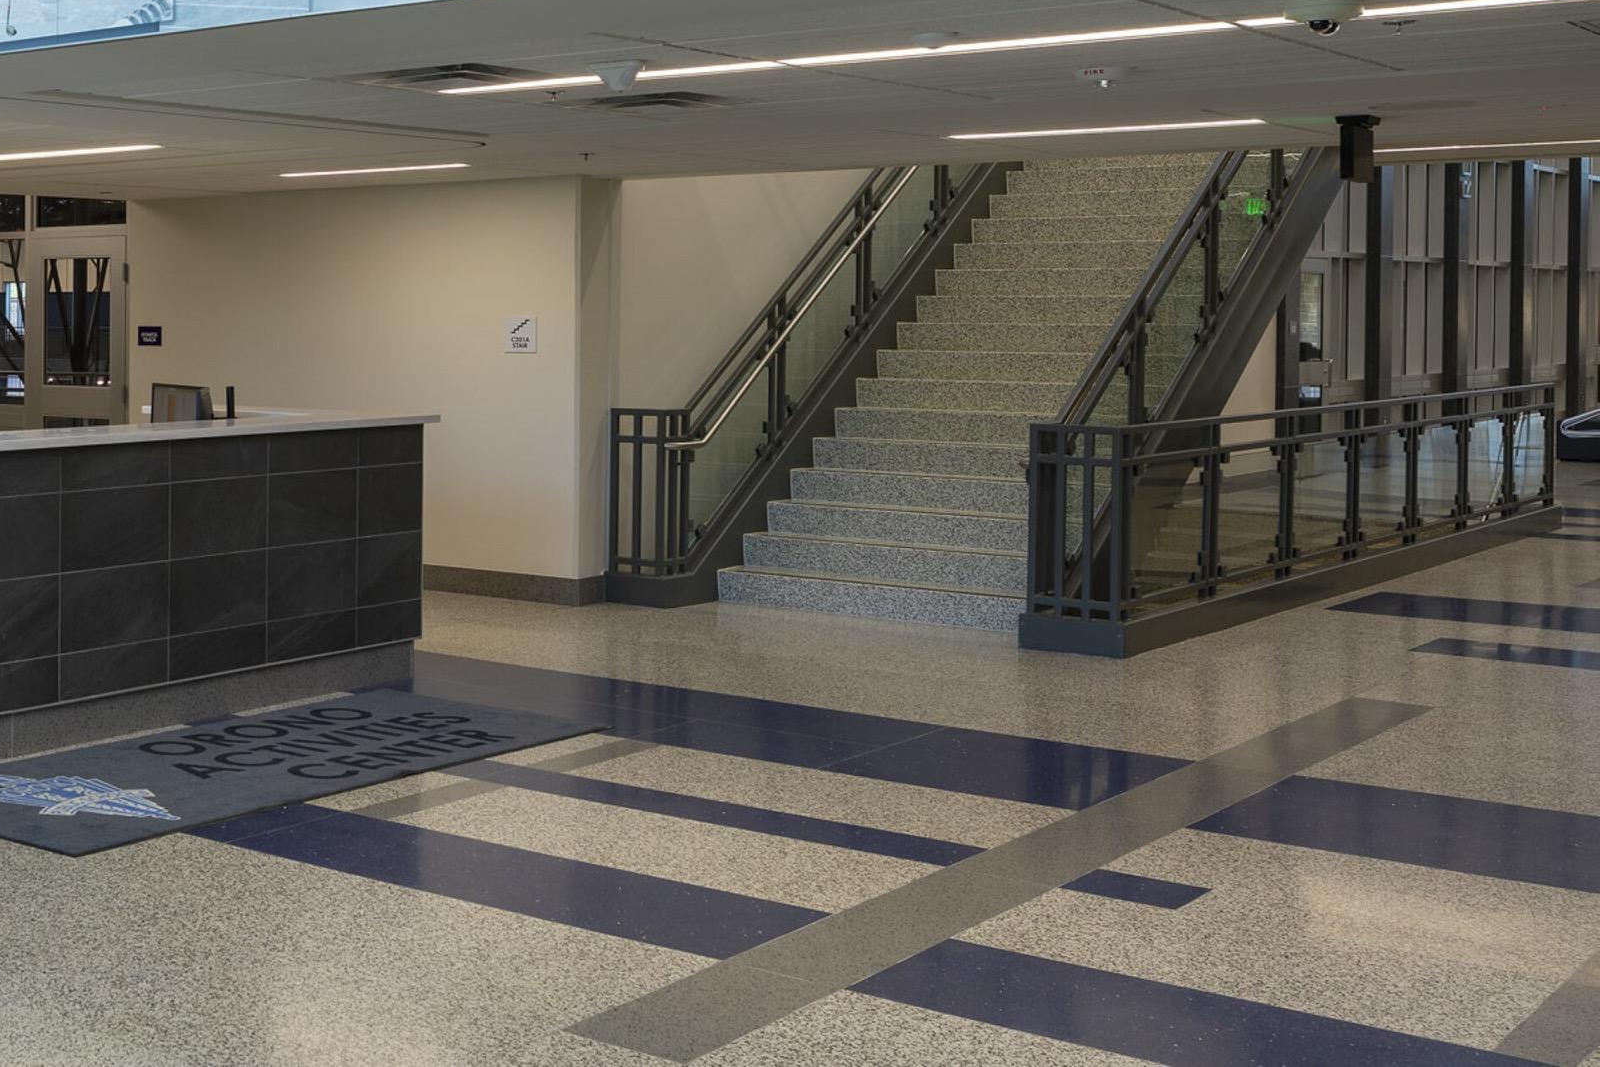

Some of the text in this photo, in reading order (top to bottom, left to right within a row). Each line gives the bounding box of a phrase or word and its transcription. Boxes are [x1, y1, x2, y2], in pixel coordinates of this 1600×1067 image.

[137, 707, 373, 756] ORONO
[172, 711, 471, 779] ACTIVITIES
[287, 728, 516, 780] CENTER
